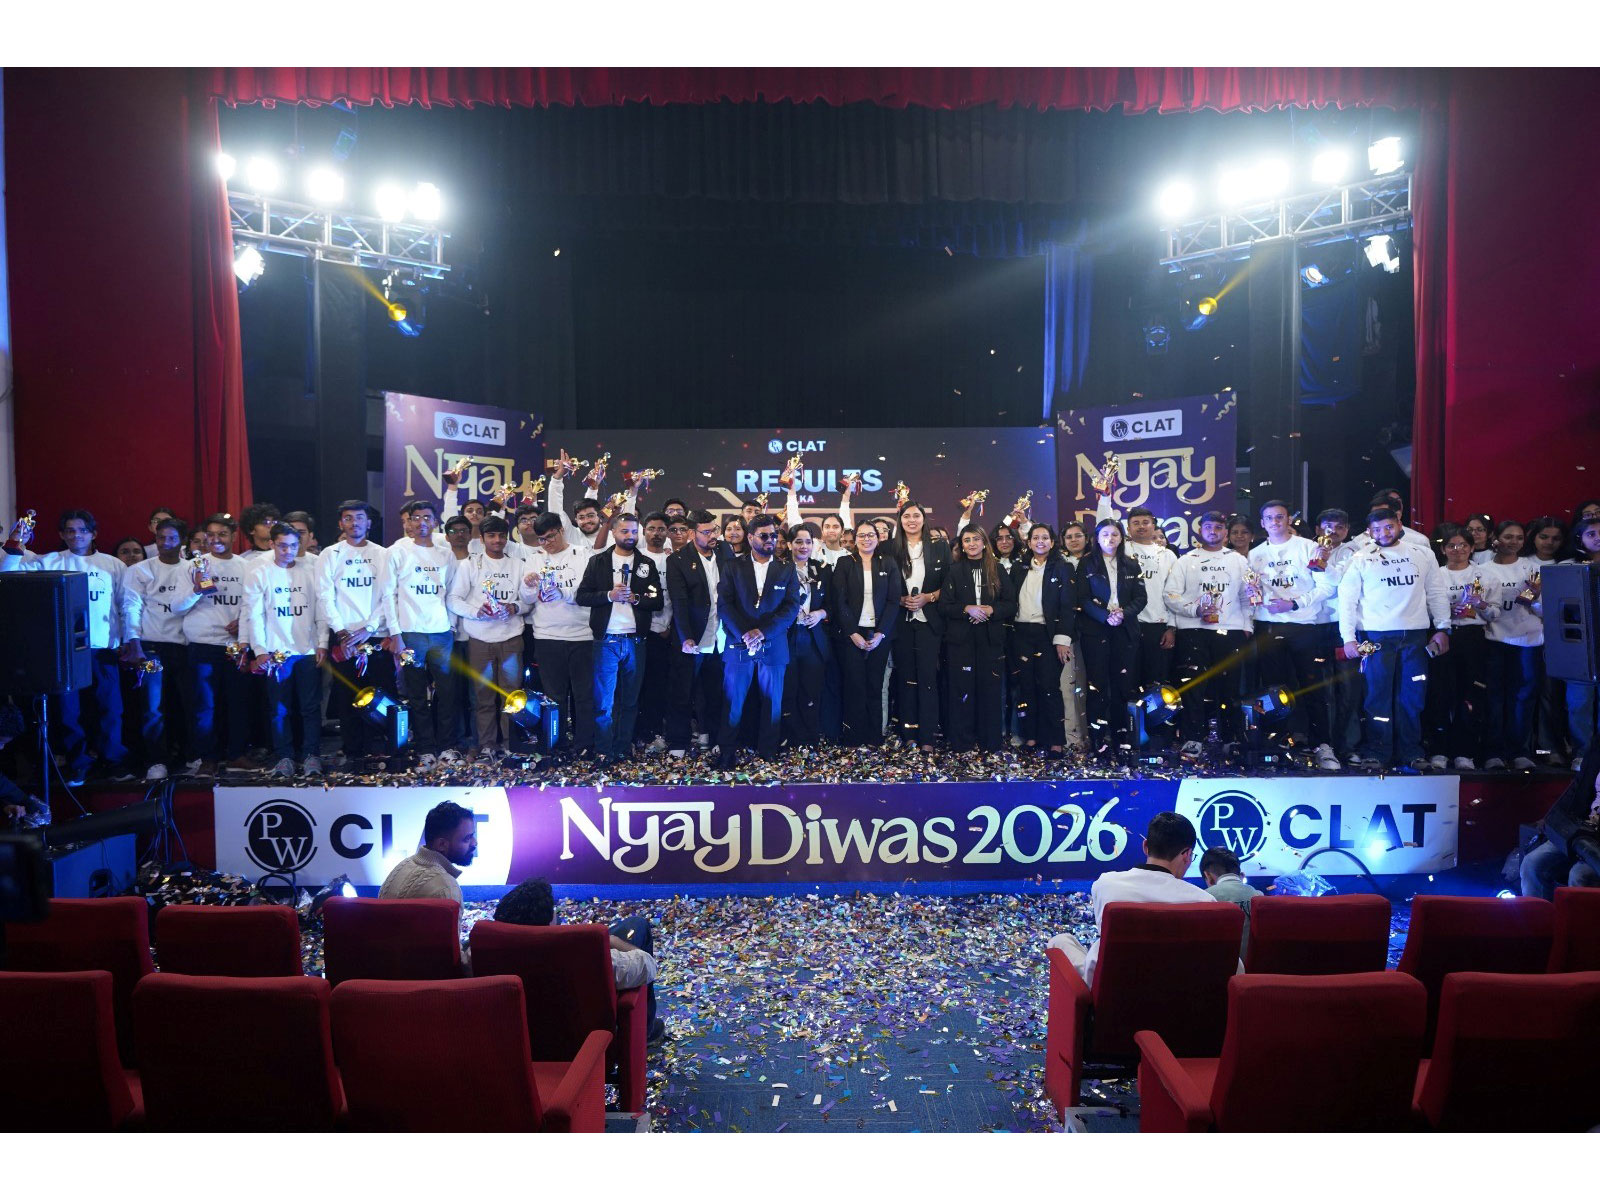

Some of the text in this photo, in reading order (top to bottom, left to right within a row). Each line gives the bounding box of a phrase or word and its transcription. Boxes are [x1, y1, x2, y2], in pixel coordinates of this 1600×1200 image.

[461, 422, 500, 440] CLAT
[1131, 417, 1176, 433] CLAT
[785, 440, 826, 452] CLAT
[799, 494, 815, 504] KA
[258, 811, 309, 867] PW
[559, 796, 1128, 874] Nyay Diwas 2026
[1209, 803, 1437, 857] PW CLAT
